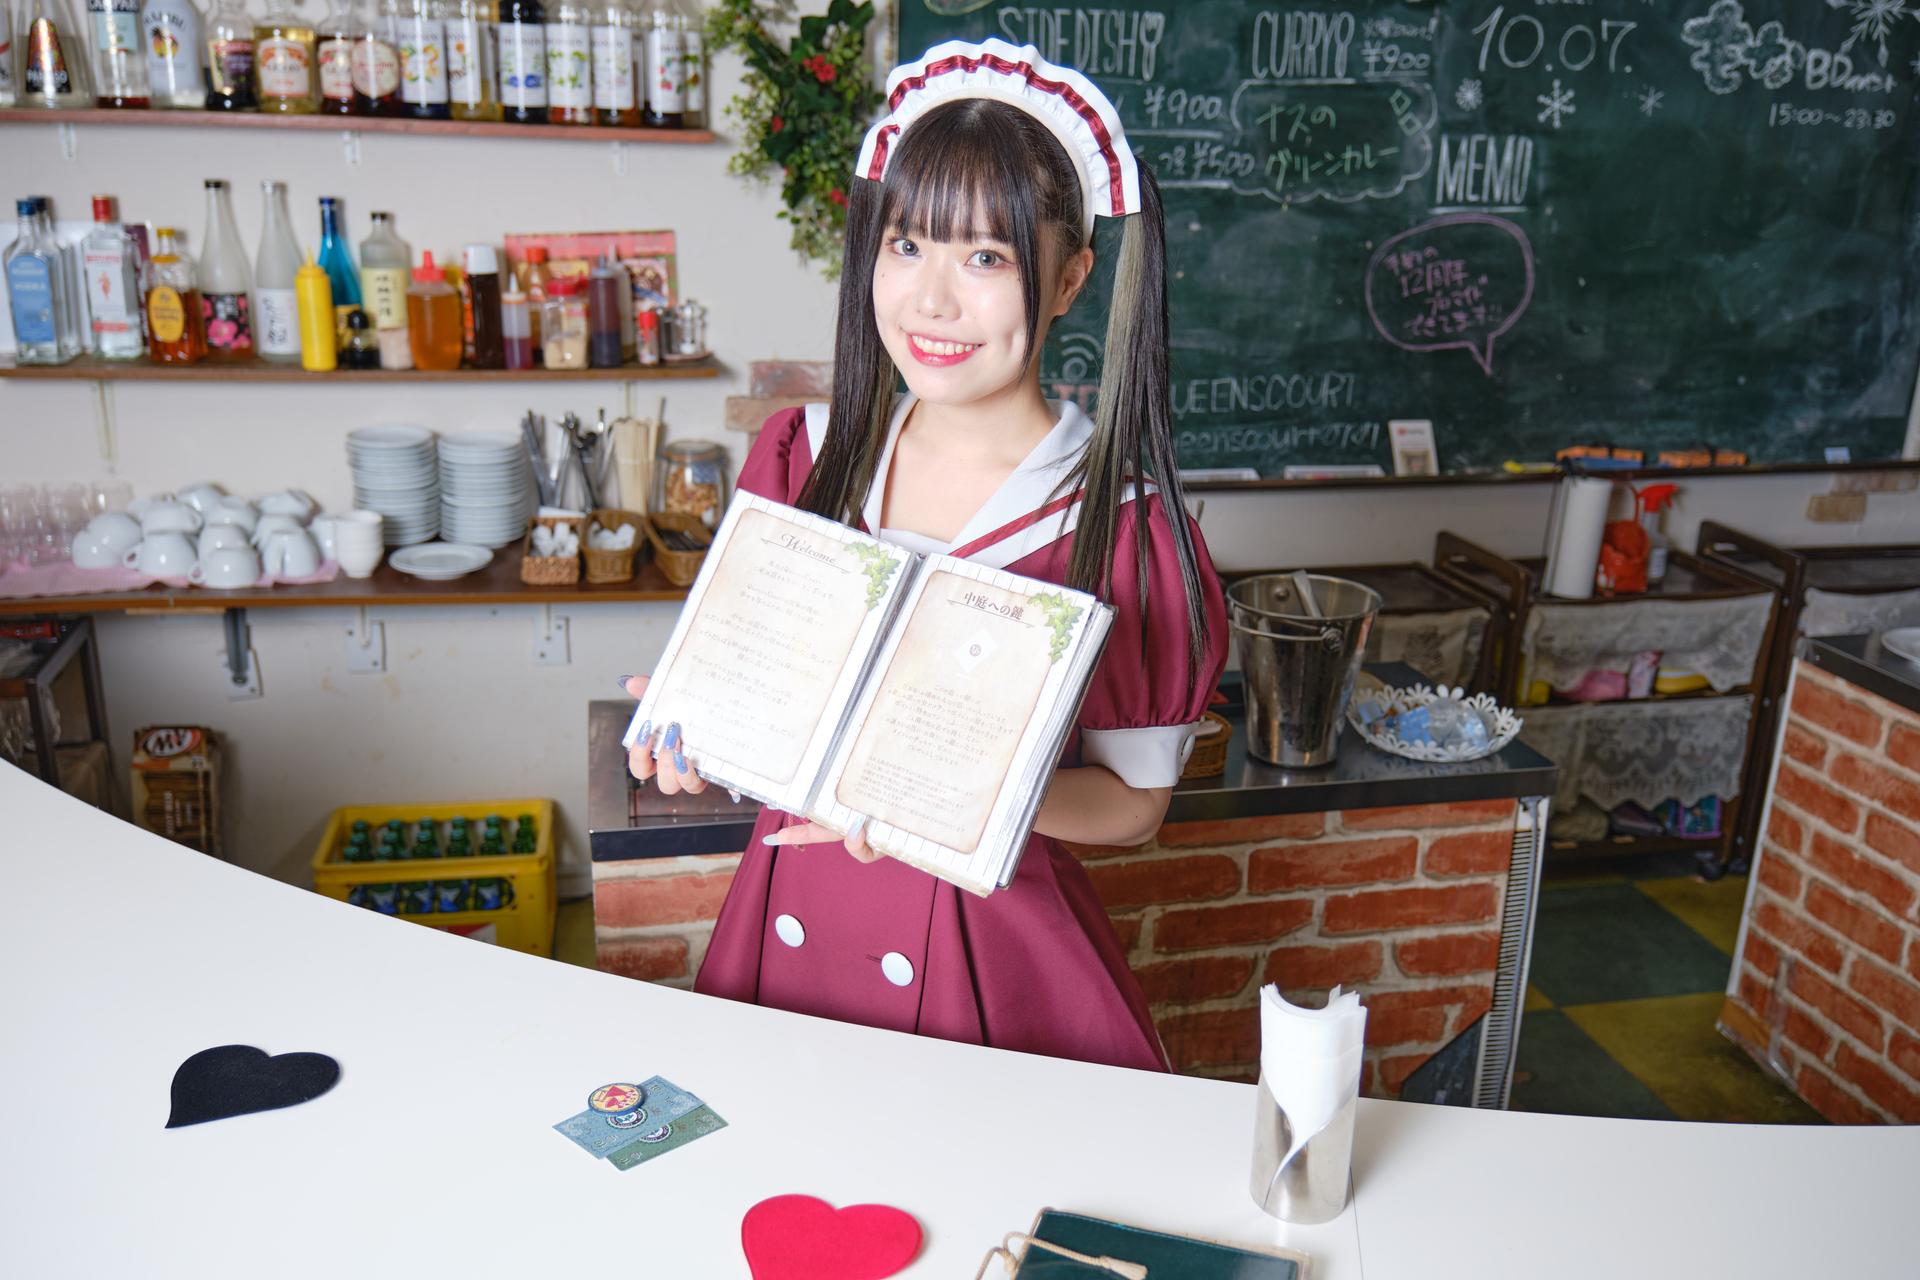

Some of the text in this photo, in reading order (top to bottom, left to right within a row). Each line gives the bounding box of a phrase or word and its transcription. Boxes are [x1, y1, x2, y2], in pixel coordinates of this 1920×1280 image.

[1252, 11, 1338, 79] CURRY
[1362, 40, 1431, 77] ¥900
[1143, 86, 1223, 127] ¥900
[1256, 103, 1337, 143] ナスの
[1191, 140, 1256, 178] ¥500
[1264, 143, 1399, 192] グリーンカレー
[1434, 133, 1534, 204] MEMO
[1169, 371, 1355, 421] UEENSCOURT
[780, 532, 838, 565] Welcome
[964, 591, 1025, 621] 中庭への鍵
